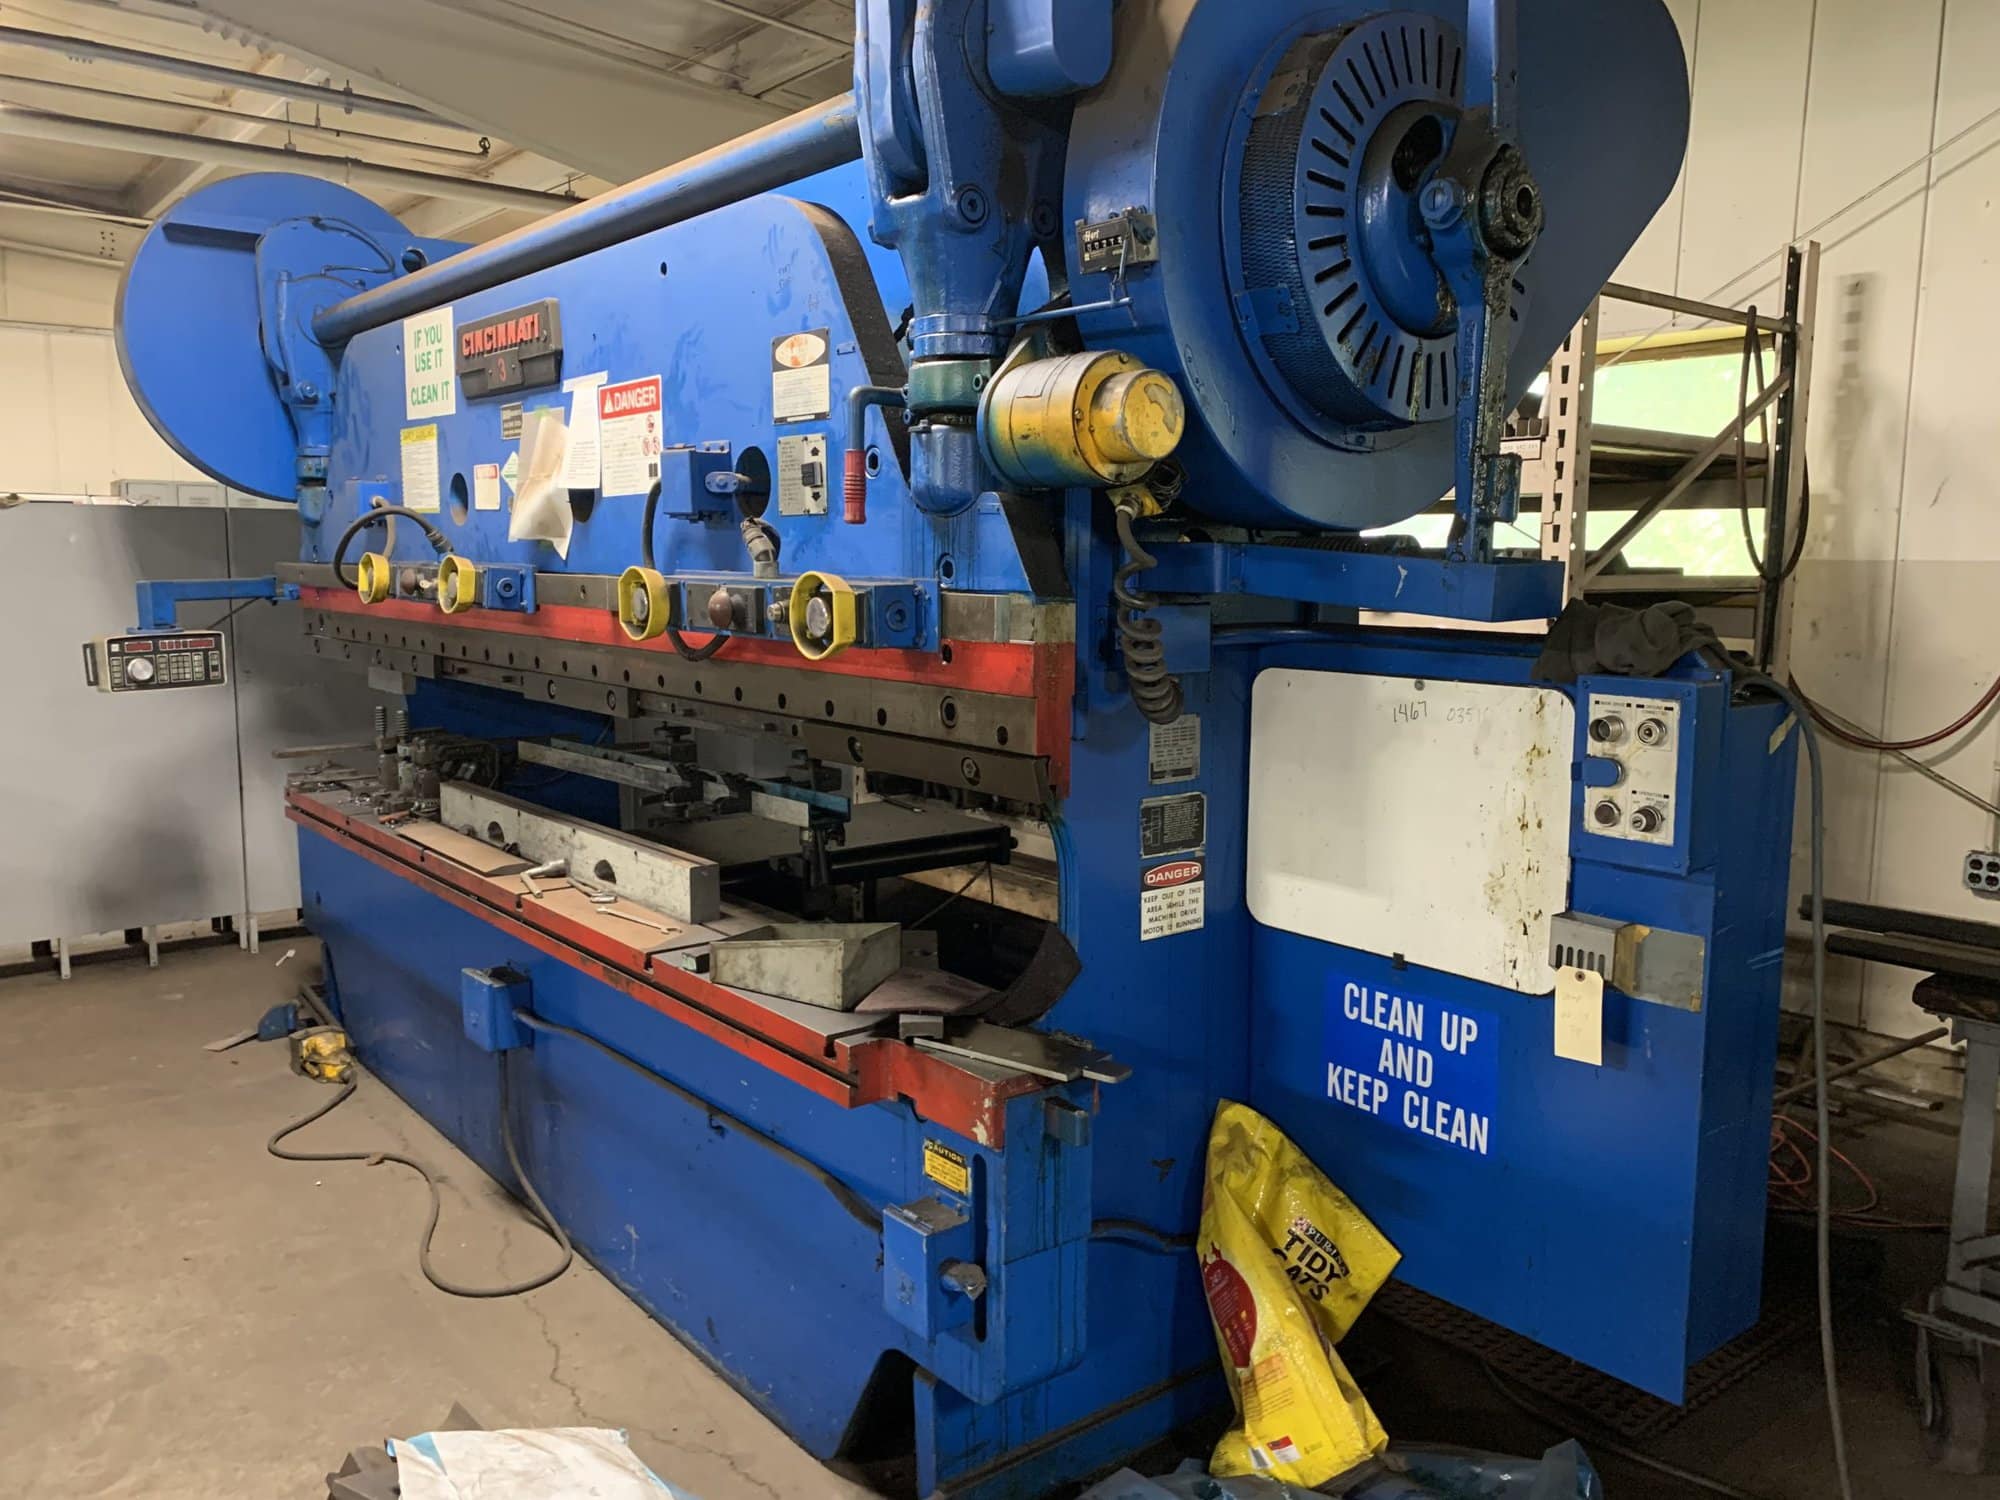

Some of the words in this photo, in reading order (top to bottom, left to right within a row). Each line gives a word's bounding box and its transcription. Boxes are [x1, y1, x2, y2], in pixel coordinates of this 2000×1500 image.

[414, 329, 422, 348] IF
[425, 324, 442, 345] YOU
[461, 313, 540, 357] CINCINNATI
[415, 353, 432, 372] USE
[435, 349, 444, 368] IT
[498, 357, 506, 382] 3
[411, 385, 438, 405] CLEAN
[442, 381, 450, 400] IT
[614, 385, 657, 411] DANGER
[1393, 701, 1427, 723] 1467
[1147, 866, 1199, 883] DANGER
[1144, 895, 1158, 904] KEEP
[1162, 892, 1174, 901] OUT
[1177, 889, 1185, 897] OF
[1189, 887, 1201, 895] THIS
[1147, 905, 1162, 914] AREA
[1166, 900, 1185, 909] WHILE
[1188, 897, 1199, 905] THE
[1143, 926, 1164, 935] MOTOR
[1176, 917, 1201, 929] RUNNING
[1149, 912, 1177, 923] MACHINE
[1180, 908, 1197, 917] DRIVE
[1344, 982, 1423, 1041] CLEAN
[1440, 1010, 1478, 1055] UP
[1378, 1038, 1433, 1088] AND
[1327, 1062, 1388, 1115] KEEP
[1403, 1090, 1488, 1155] CLEAN
[926, 1141, 963, 1163] CAUTION
[1284, 1229, 1341, 1283] TIDY
